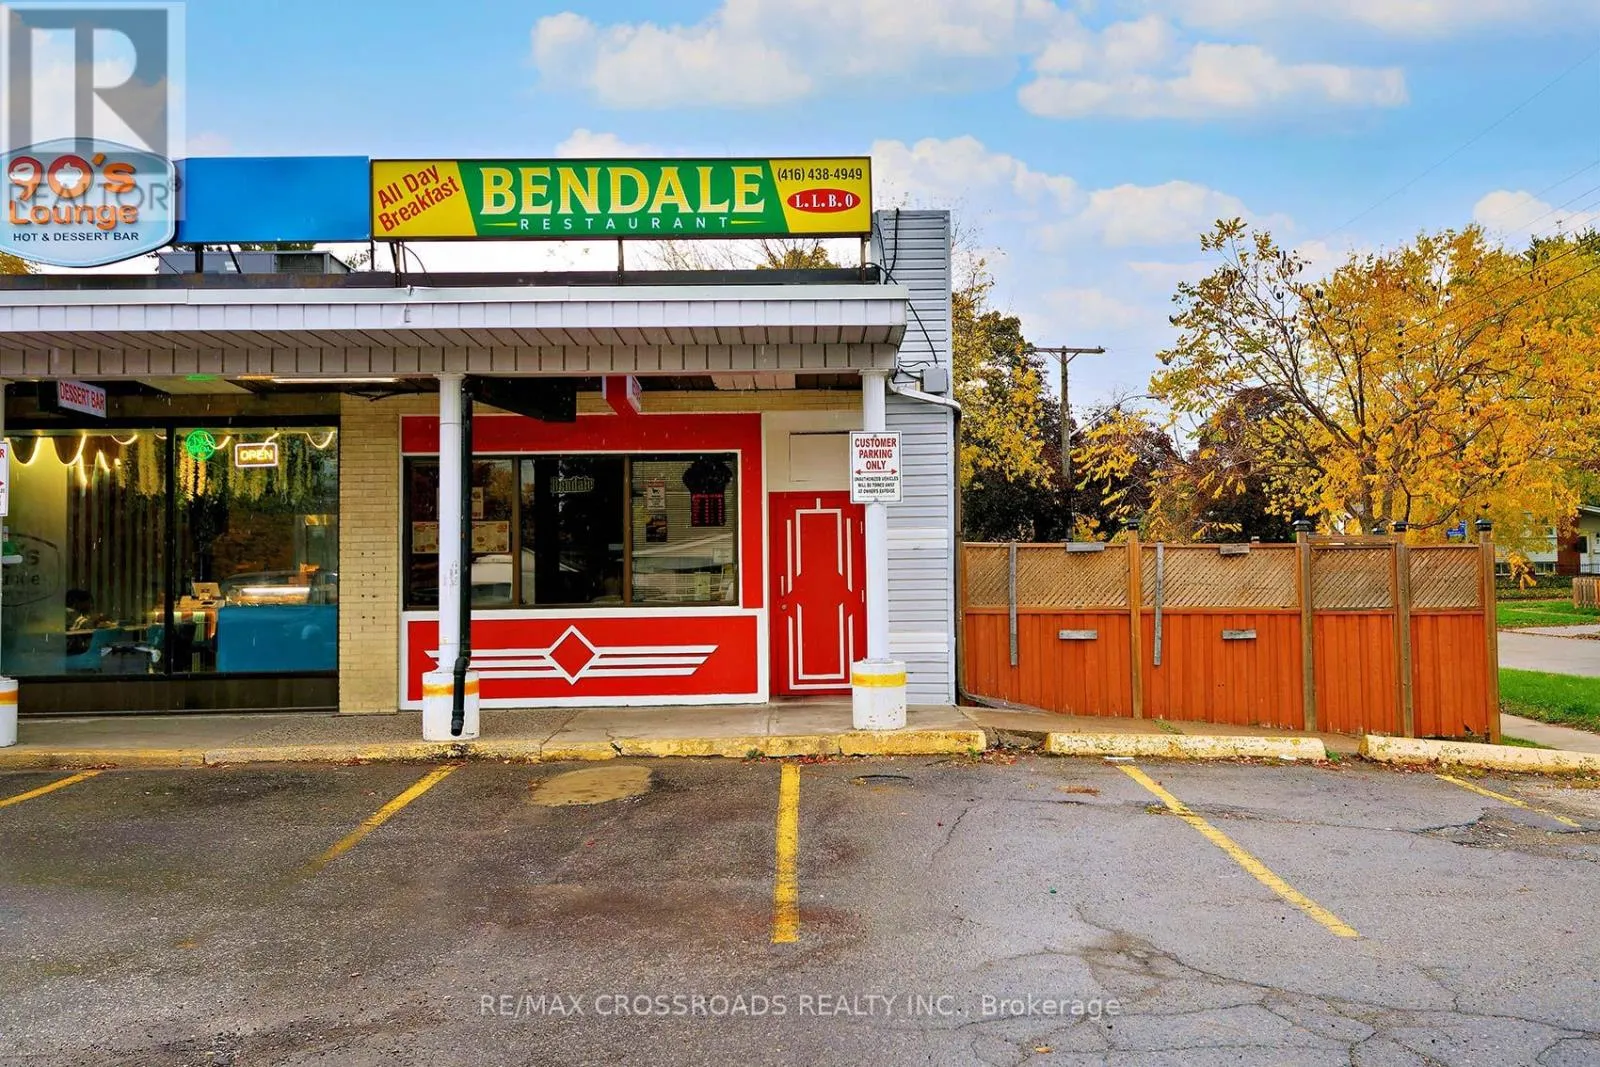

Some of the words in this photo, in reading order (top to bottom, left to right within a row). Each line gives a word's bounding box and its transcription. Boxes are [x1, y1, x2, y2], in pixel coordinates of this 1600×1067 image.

[777, 167, 806, 183] (416)
[807, 167, 863, 181] 438-4949
[377, 183, 404, 209] All
[401, 164, 441, 192] Day
[479, 166, 765, 215] BENDALE
[377, 175, 460, 233] Breakfast
[8, 200, 140, 231] Lounge
[520, 216, 728, 230] RESTAURANT
[13, 232, 40, 242] HOT
[41, 232, 50, 242] &
[53, 232, 112, 242] DESSERT
[113, 231, 139, 241] BAR
[59, 381, 90, 407] DESSERT
[91, 391, 105, 410] BAR
[855, 438, 897, 448] CUSTOMER
[239, 449, 273, 461] OPEN
[858, 449, 893, 459] PARKING
[865, 460, 886, 470] ONLY
